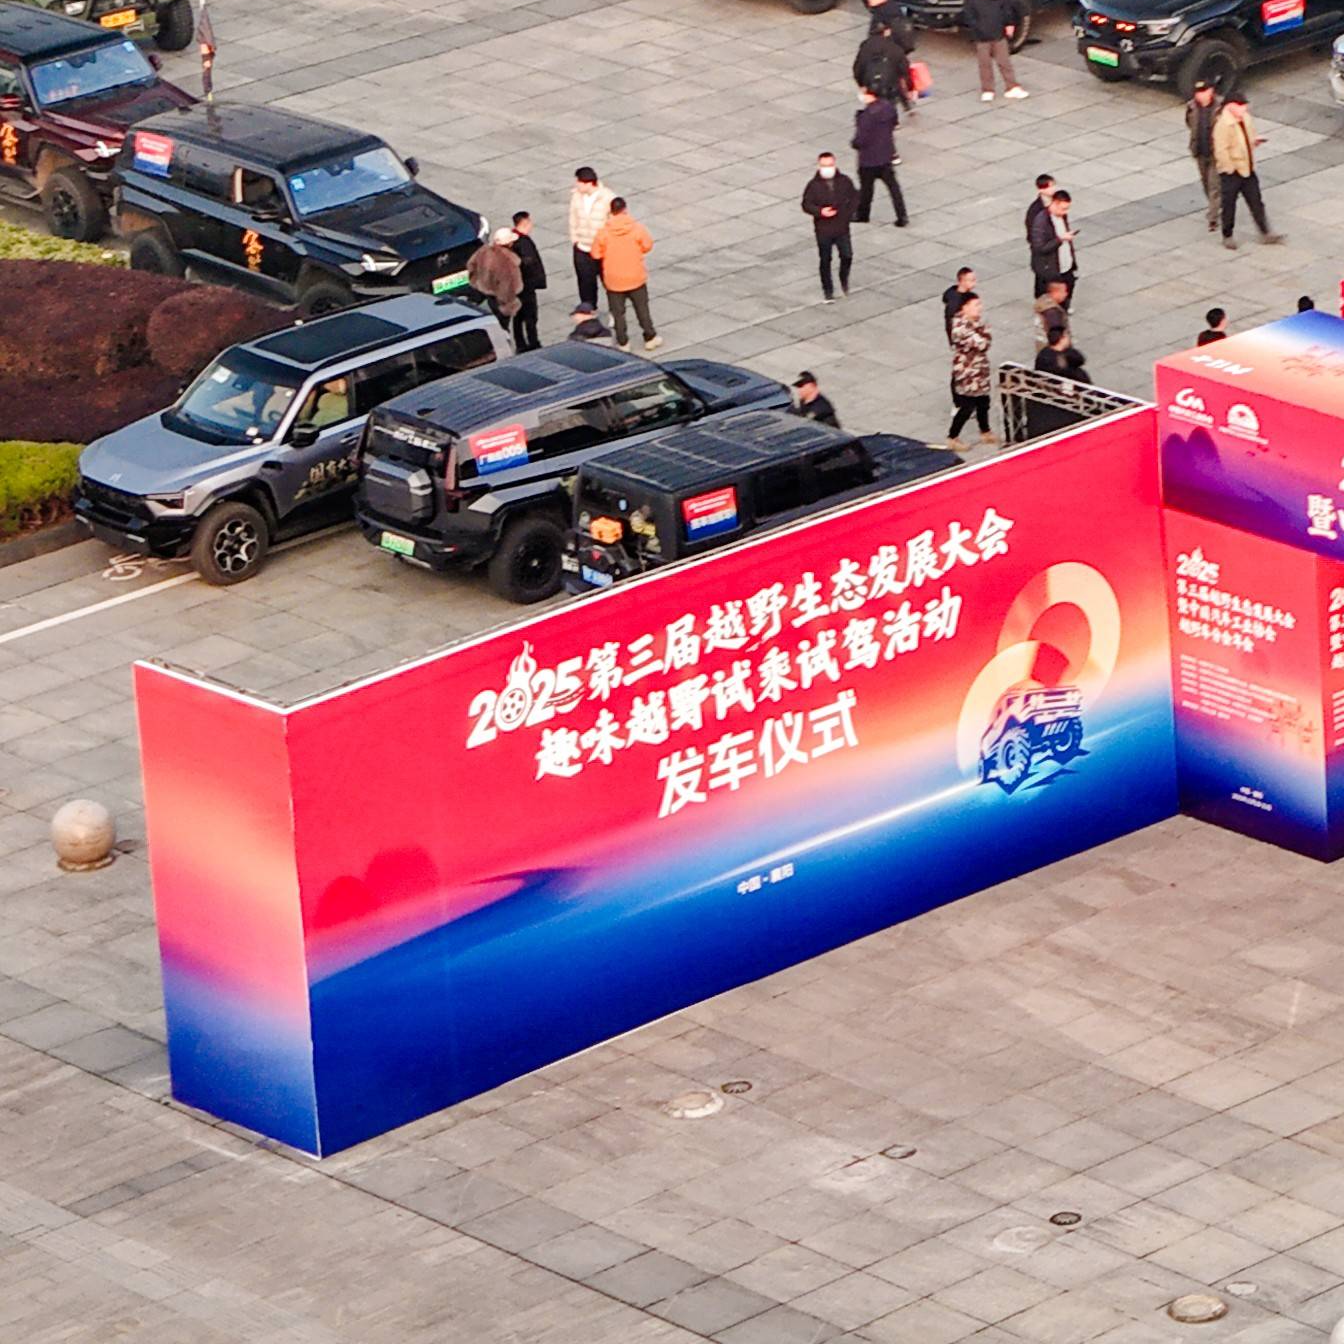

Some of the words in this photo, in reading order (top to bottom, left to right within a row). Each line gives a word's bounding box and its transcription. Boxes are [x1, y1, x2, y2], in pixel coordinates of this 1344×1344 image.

[466, 506, 1013, 750] 2025第三届越野生态发展大会
[535, 586, 961, 782] 趣味越野试乘试驾活动
[656, 686, 858, 818] 发车仪式
